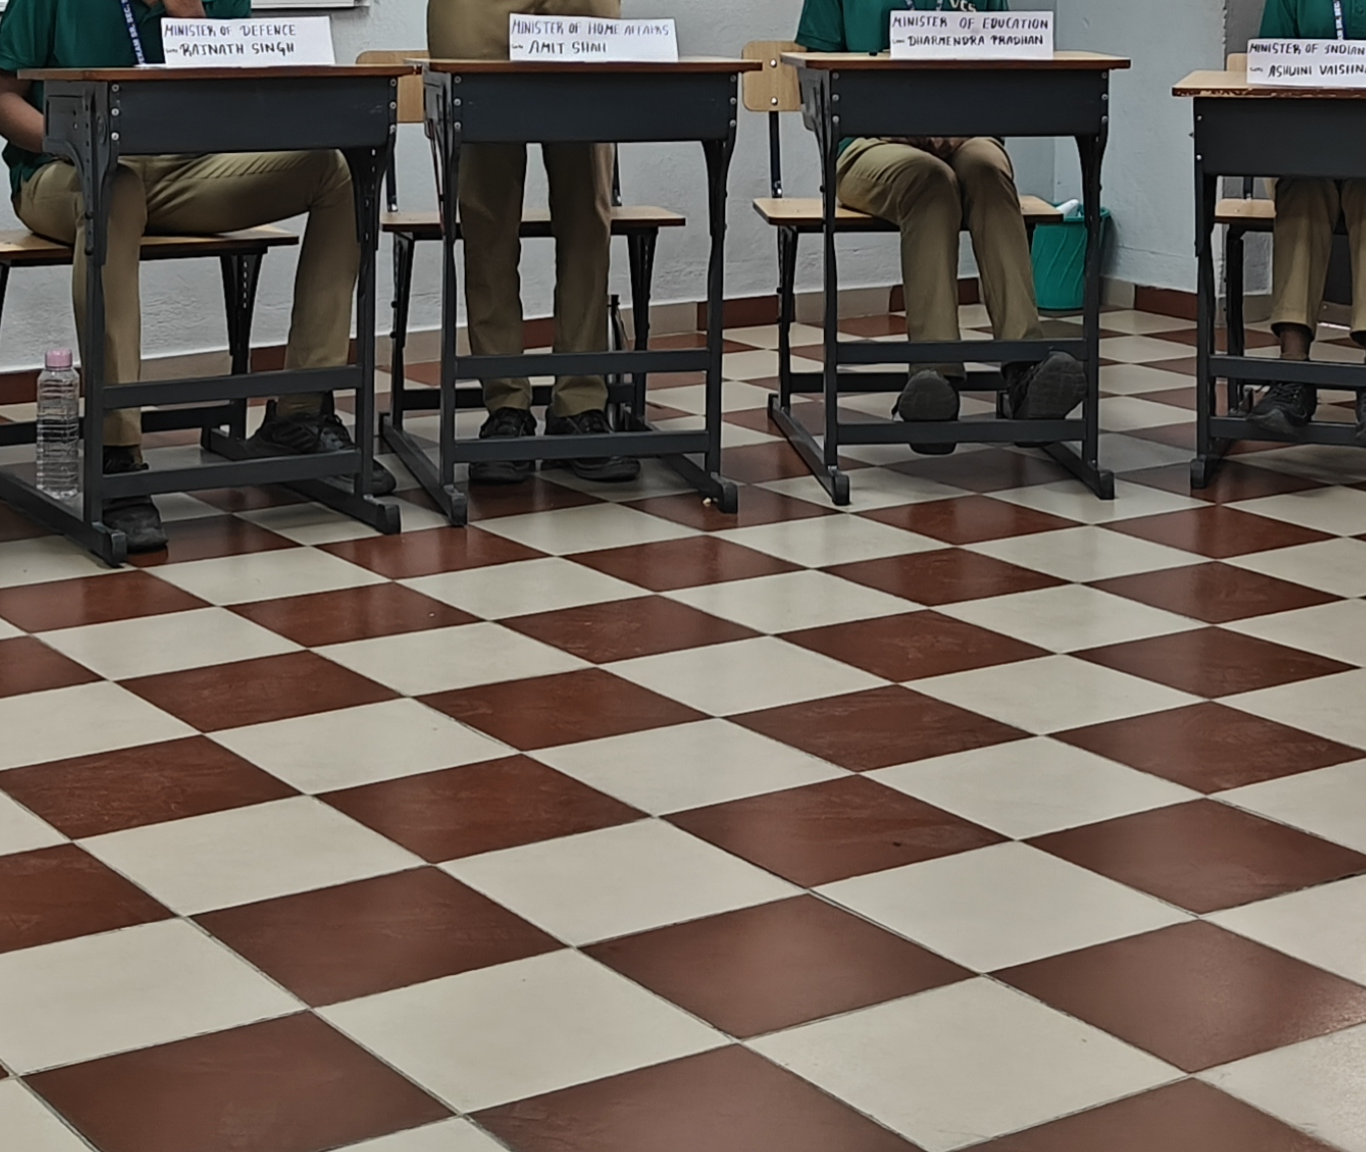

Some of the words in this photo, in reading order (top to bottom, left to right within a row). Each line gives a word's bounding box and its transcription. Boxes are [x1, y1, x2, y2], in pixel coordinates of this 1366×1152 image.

[511, 19, 564, 35] MINISTER
[568, 22, 581, 34] OF
[588, 23, 618, 35] HOME
[892, 15, 947, 29] MINISTER
[959, 16, 975, 29] OF
[983, 17, 1048, 29] EDUCATION
[164, 24, 216, 38] MINISTER
[220, 25, 232, 35] OF
[240, 24, 296, 36] DEFENCE
[529, 40, 565, 54] AMIT
[572, 41, 607, 53] SHAH
[908, 35, 985, 46] DHARMENDRA
[990, 35, 1043, 46] PRADHAN
[179, 43, 244, 57] RAJNATH
[252, 42, 295, 56] SINGH
[1249, 43, 1301, 55] MINISTER
[1305, 43, 1318, 53] OF
[1325, 44, 1365, 55] INDIAN
